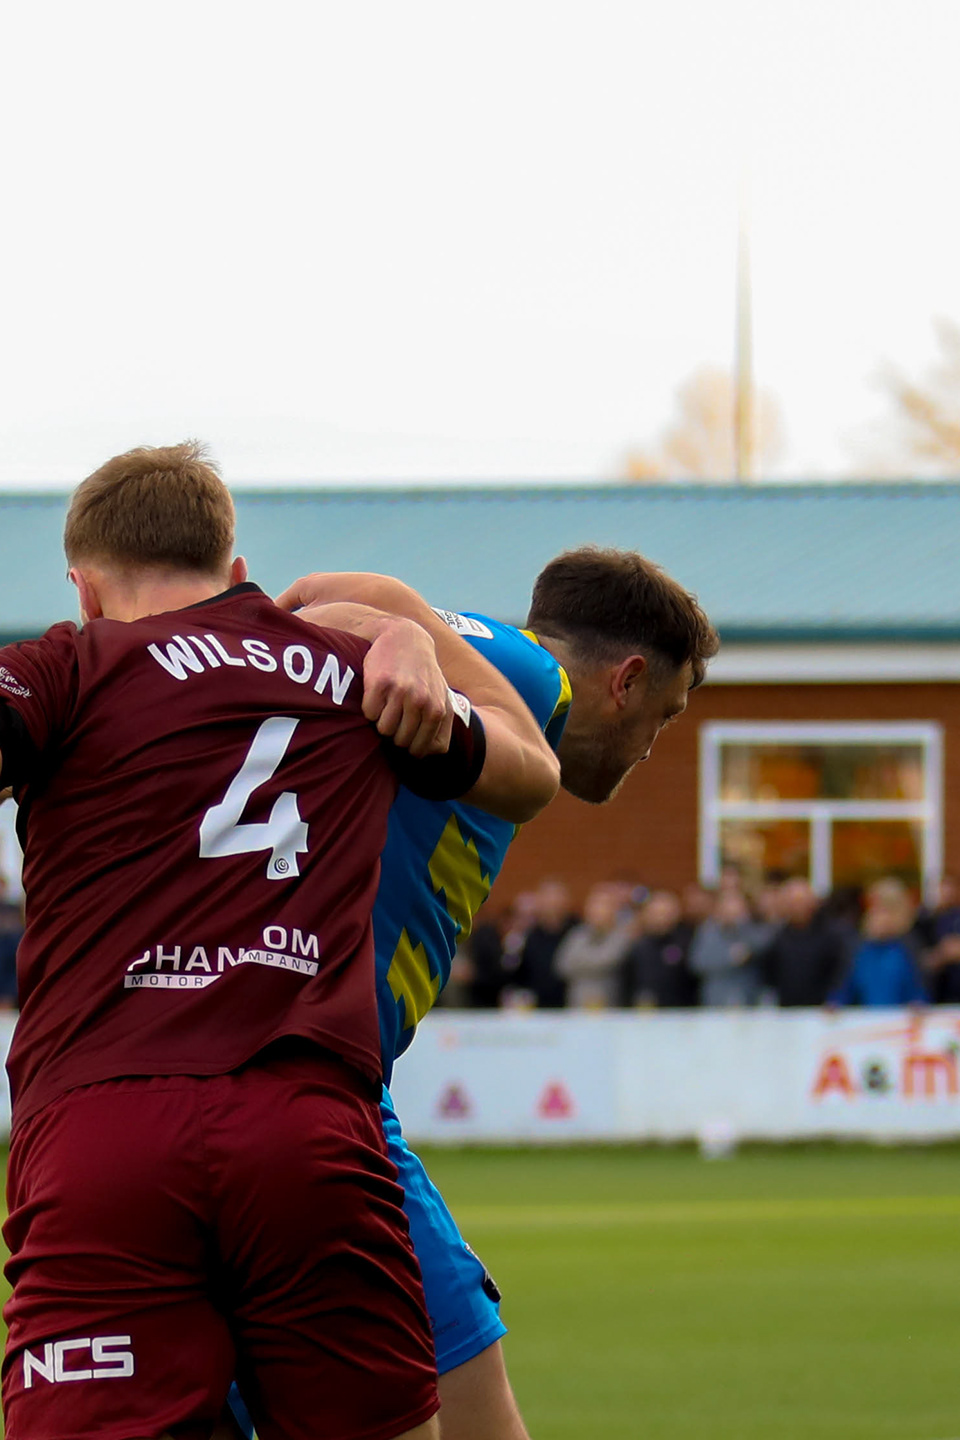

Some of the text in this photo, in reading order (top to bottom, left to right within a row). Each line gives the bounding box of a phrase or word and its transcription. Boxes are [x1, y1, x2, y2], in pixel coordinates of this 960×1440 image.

[146, 633, 355, 706] WILSON
[198, 716, 309, 880] 4
[130, 975, 205, 988] MOTOR
[23, 1335, 135, 1389] NCS
